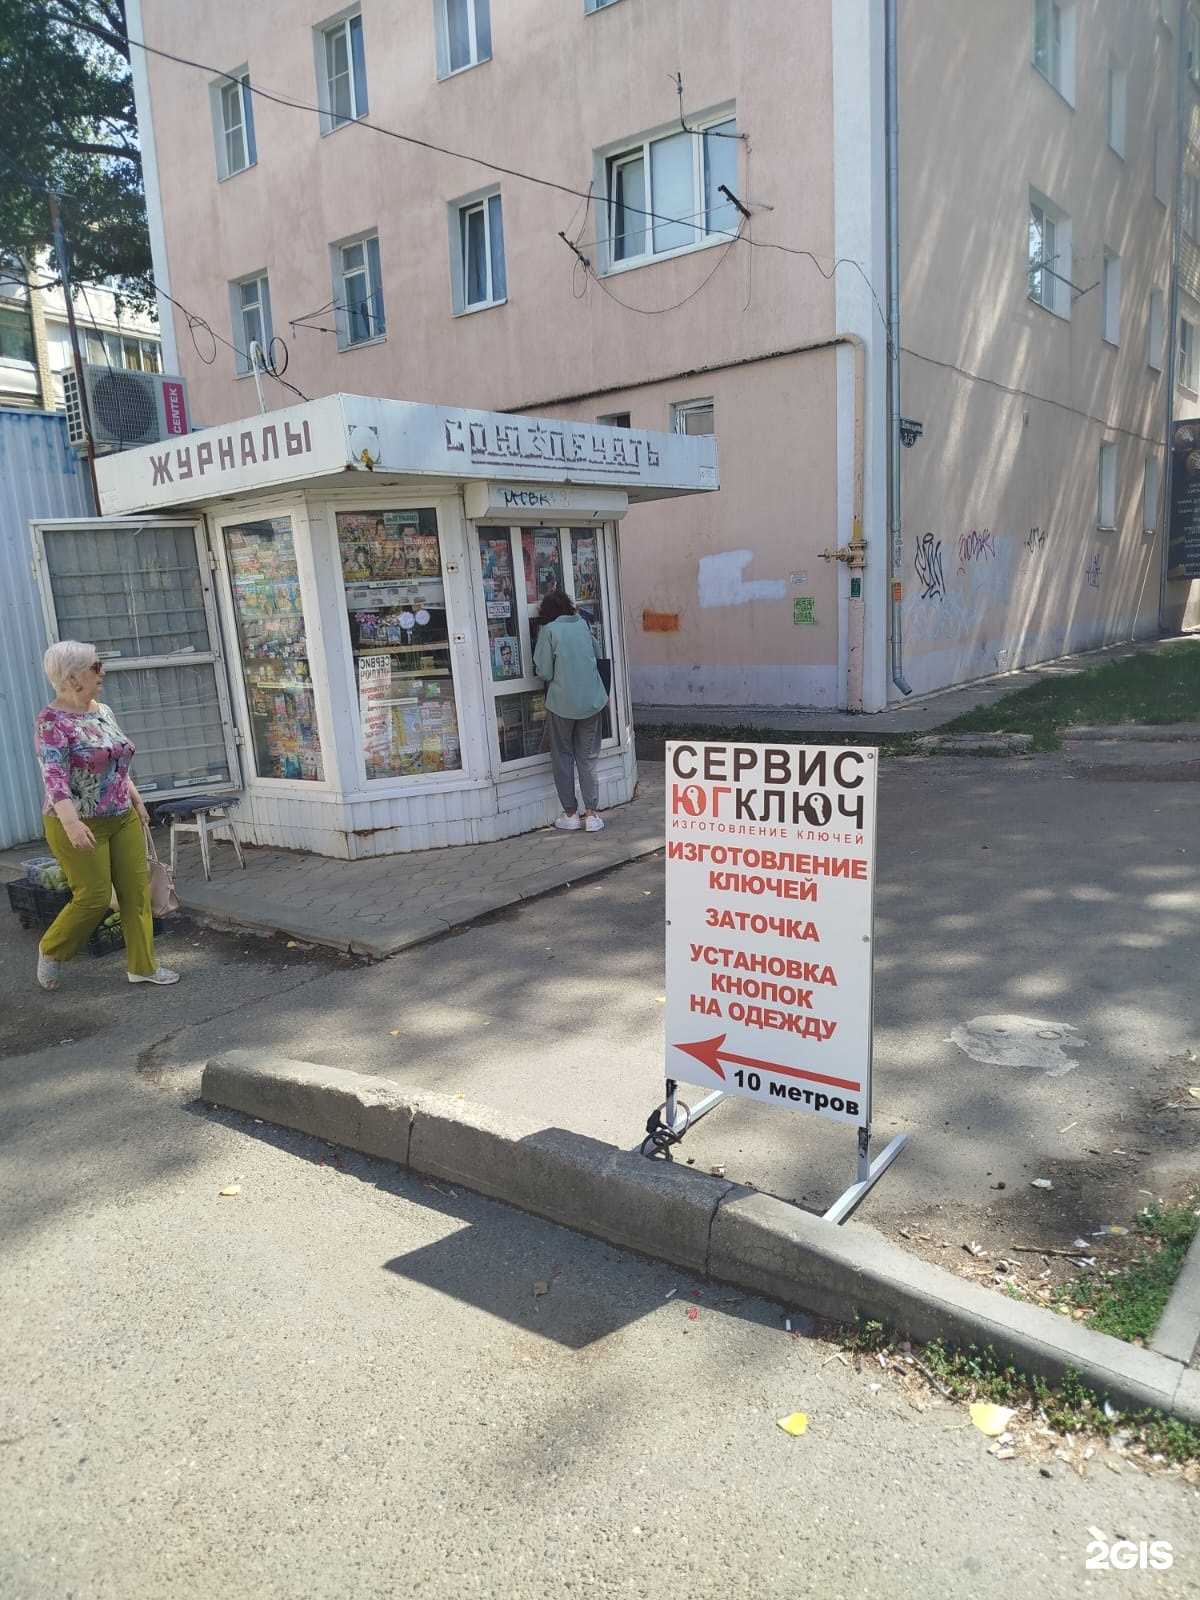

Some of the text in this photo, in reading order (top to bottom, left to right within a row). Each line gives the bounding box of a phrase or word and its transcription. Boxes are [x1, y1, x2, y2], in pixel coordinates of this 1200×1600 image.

[169, 384, 182, 434] CENTEK
[149, 420, 312, 487] ЖУРНАЛЫ
[672, 745, 865, 789] СЕРВИС
[672, 783, 865, 830] ЮГКЛЮЧ
[672, 820, 864, 845] ИЗГОТОВЛЕНИЕ КЛЮЧЕЙ
[668, 841, 868, 880] ИЗГОТОВЛЕНИЕ
[709, 871, 818, 902] КЛЮЧЕЙ
[706, 908, 820, 942] ЗАТОЧКА
[690, 943, 838, 986] УСТАНОВКА
[711, 973, 814, 1009] КНОПОК
[690, 994, 838, 1042] НА ОДЕЖДУ
[734, 1070, 860, 1116] 10 метров
